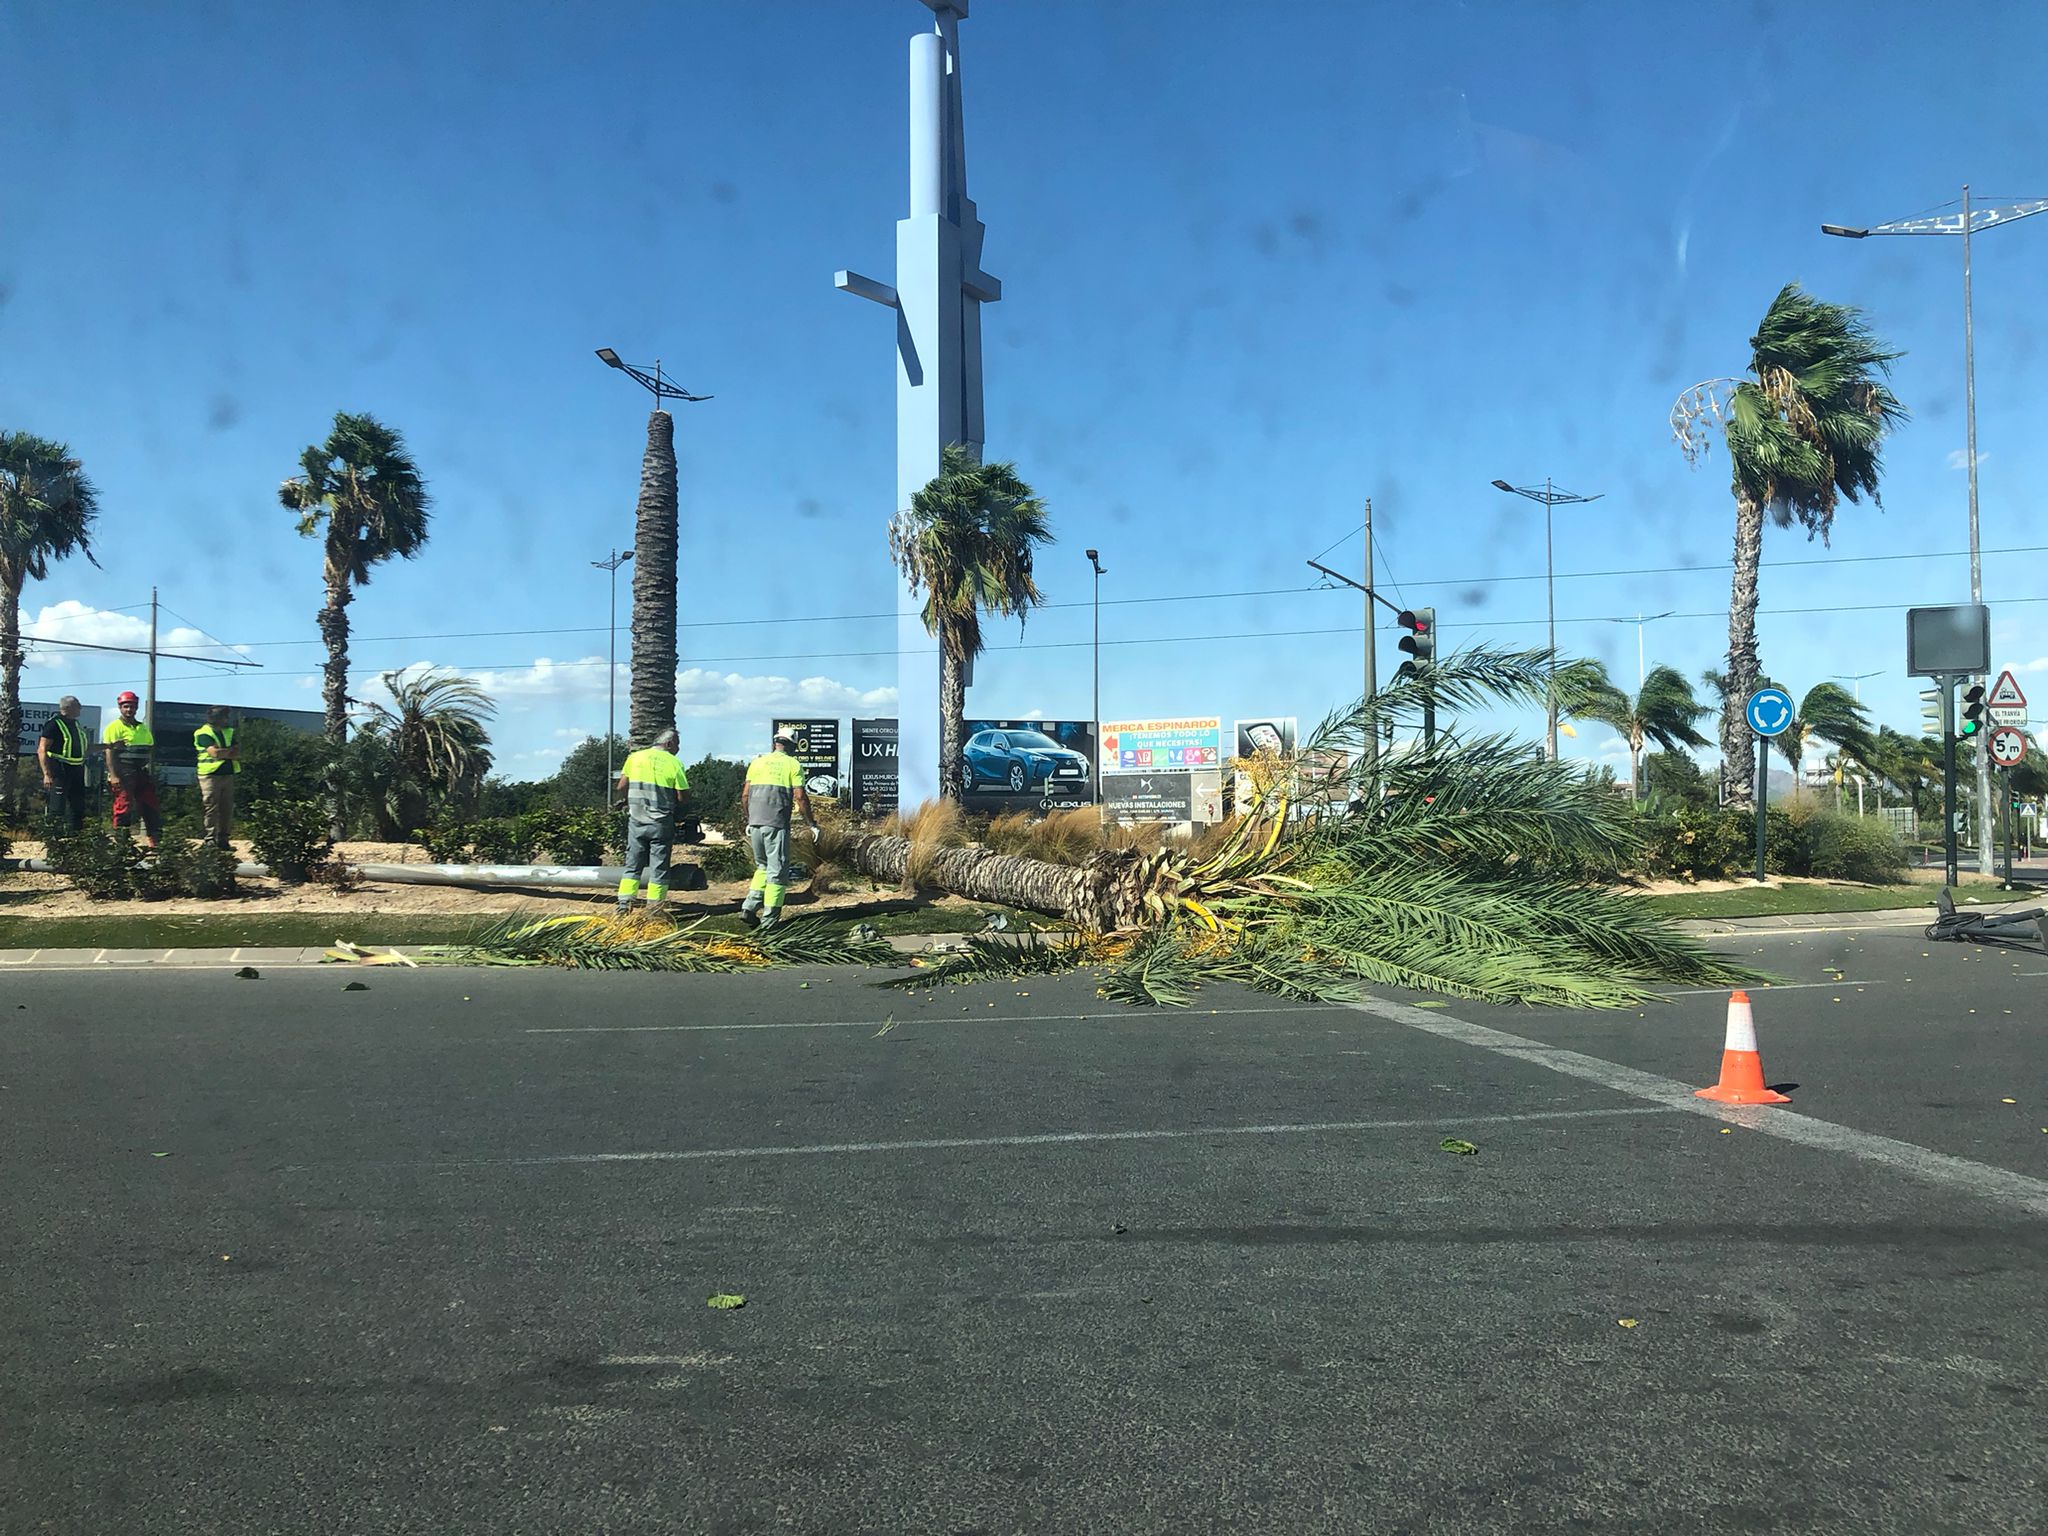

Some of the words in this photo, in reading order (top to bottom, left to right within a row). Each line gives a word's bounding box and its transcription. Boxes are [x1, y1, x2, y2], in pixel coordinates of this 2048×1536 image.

[1102, 724, 1144, 733] MERCA
[1148, 720, 1217, 731] ESPINARDO
[861, 743, 883, 757] UX
[1996, 740, 2006, 752] 5
[1108, 801, 1133, 809] NUEVAS
[1134, 801, 1186, 809] INSTALACIONES
